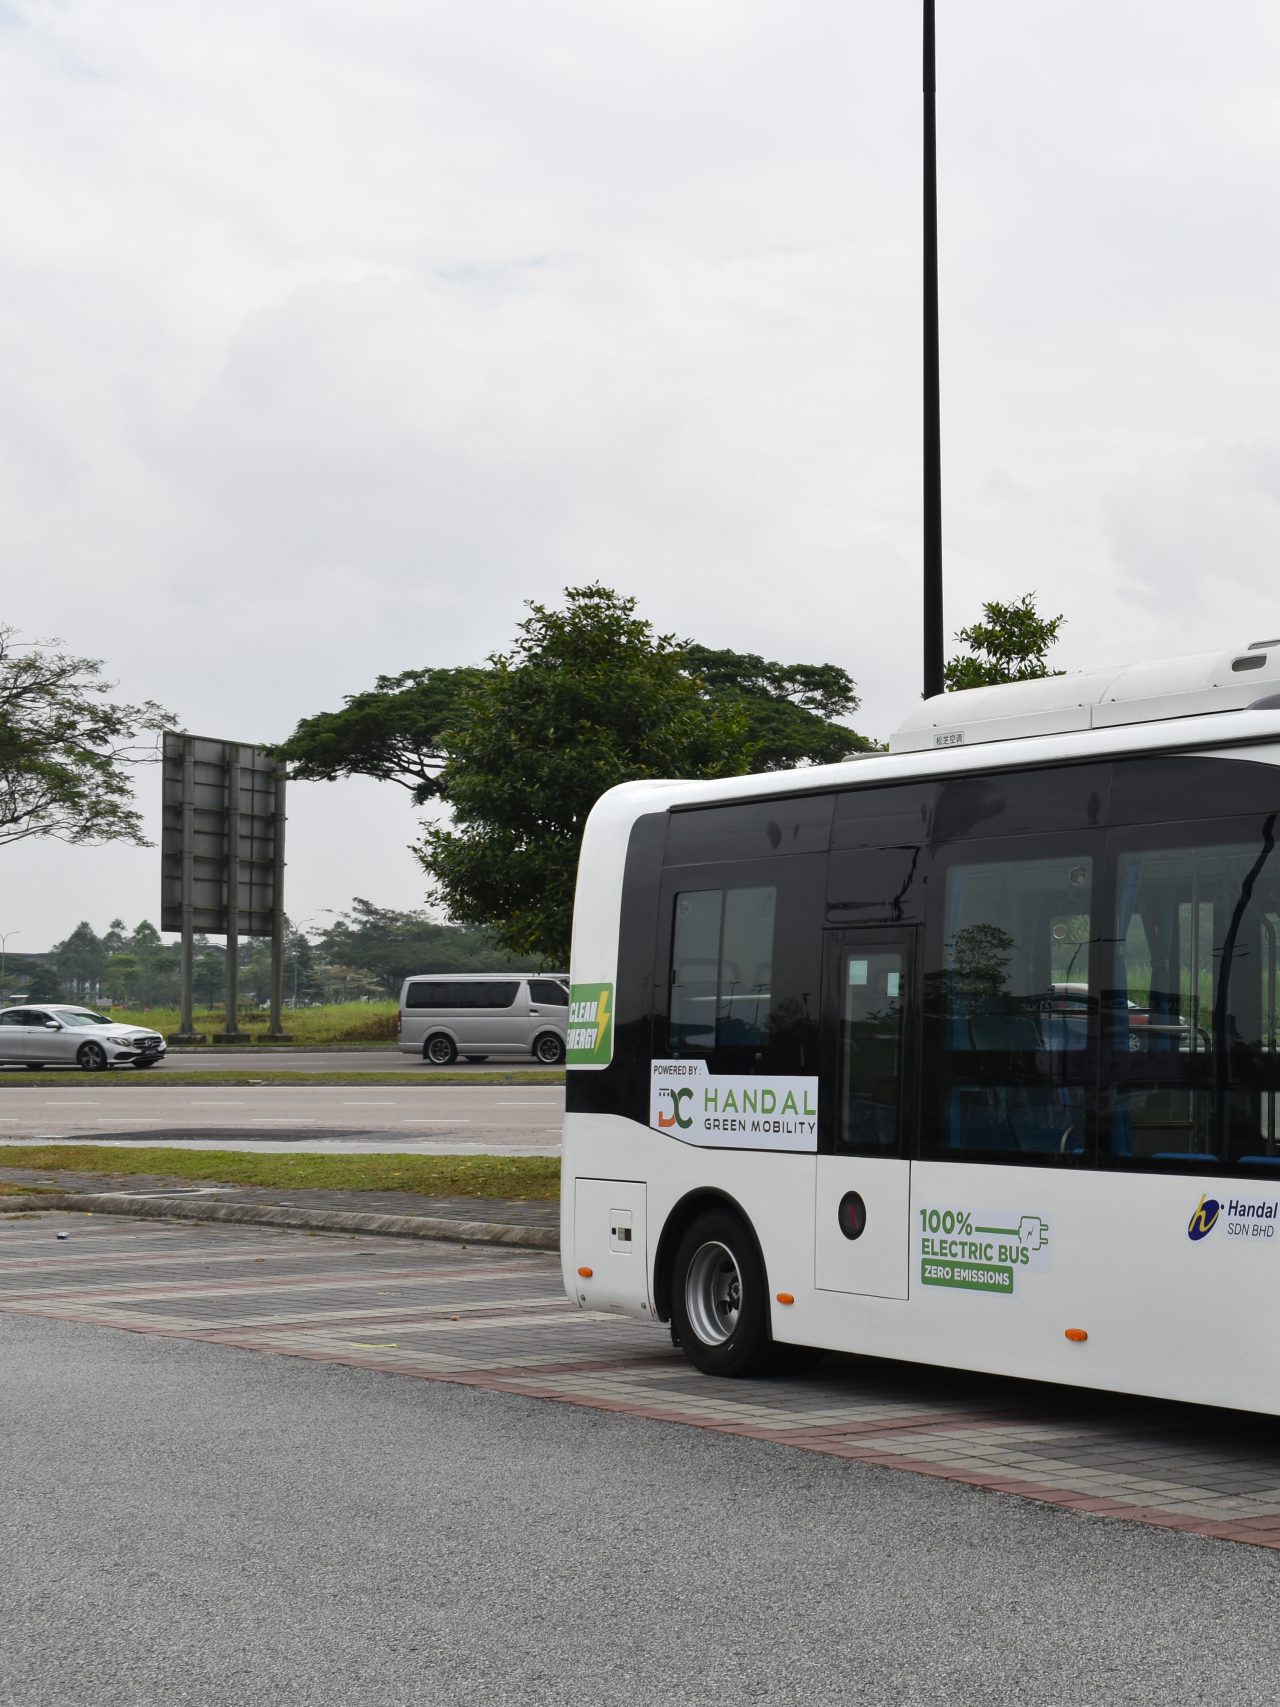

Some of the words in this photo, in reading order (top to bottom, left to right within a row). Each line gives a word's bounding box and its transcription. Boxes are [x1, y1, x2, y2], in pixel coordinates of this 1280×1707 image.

[936, 733, 963, 746] 松芝空调
[569, 1001, 598, 1023] CLEAN
[653, 1065, 687, 1076] POWERED
[704, 1087, 817, 1116] HANDAL
[704, 1118, 746, 1132] GREEN
[751, 1120, 816, 1135] MOBILITY
[1227, 1200, 1278, 1219] Handal
[920, 1208, 973, 1236] 100%
[1227, 1222, 1250, 1236] SDN
[1251, 1224, 1275, 1238] BHD
[921, 1237, 994, 1262] ELECTRIC
[998, 1244, 1030, 1265] BUS
[924, 1265, 952, 1280] ZERO
[954, 1267, 1010, 1286] EMISSIONS
